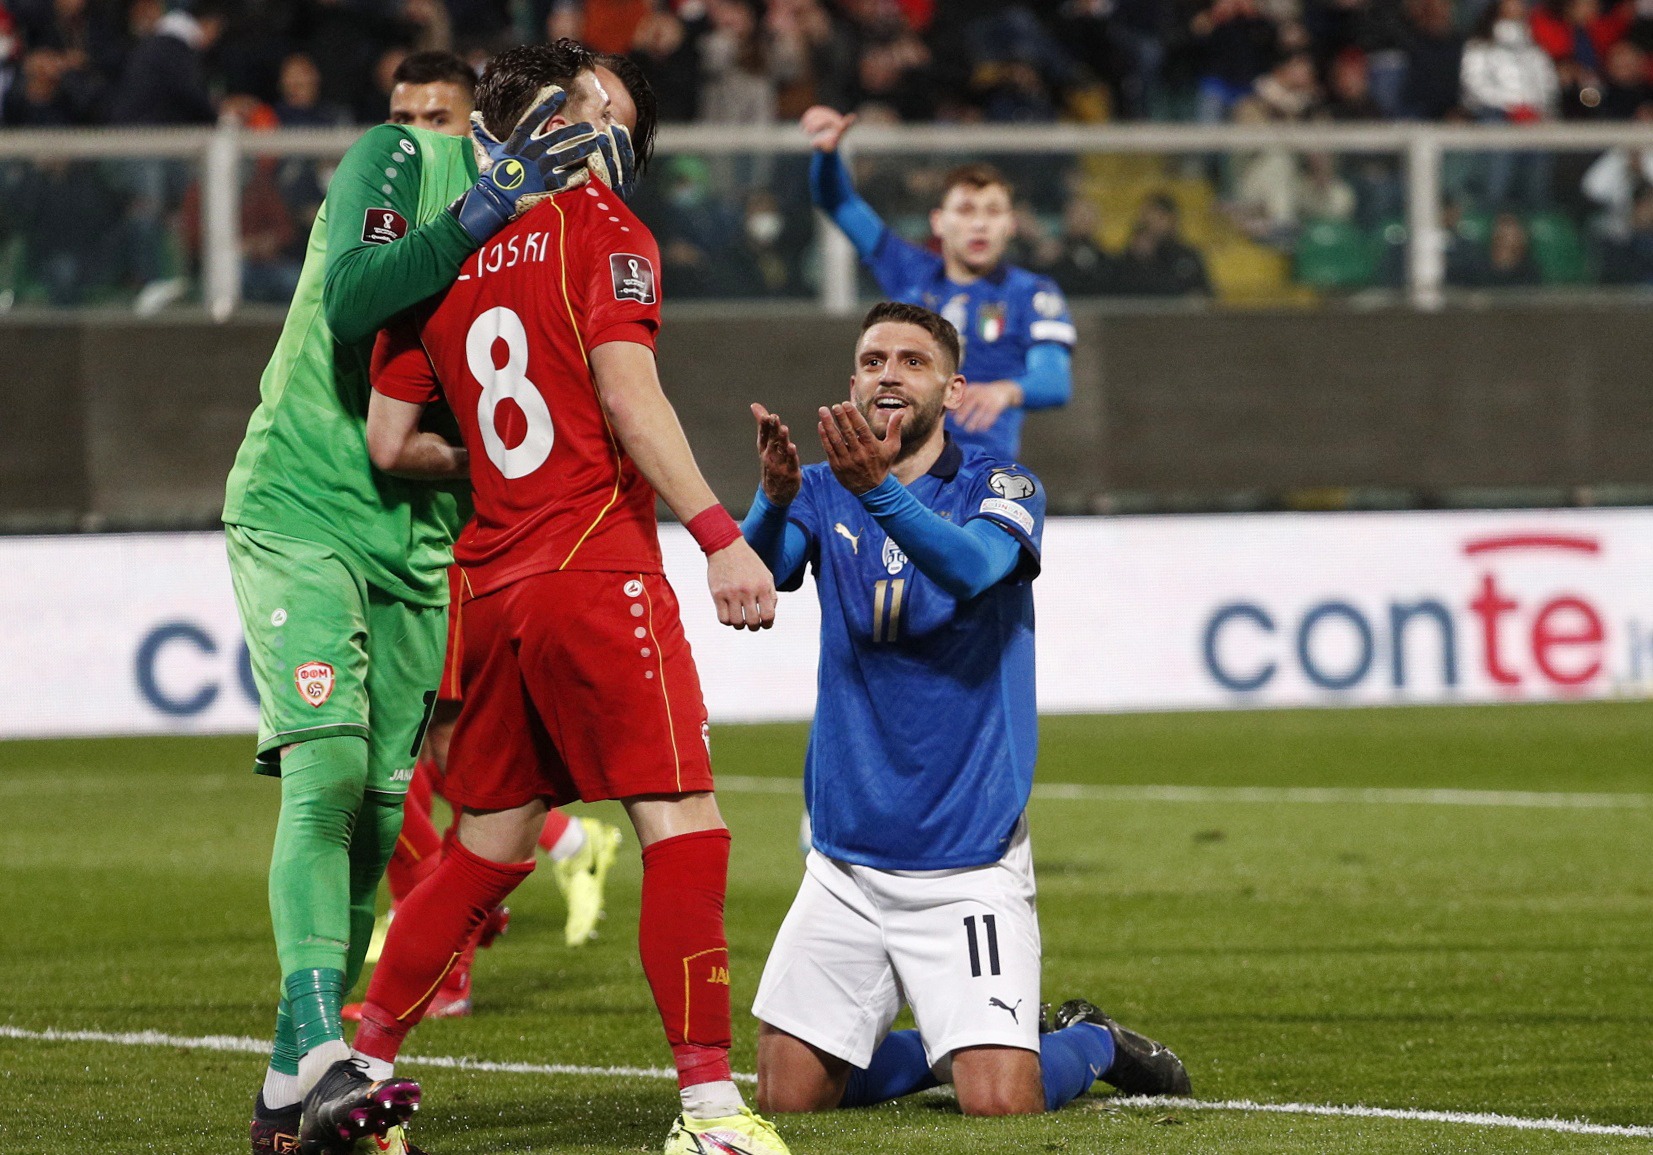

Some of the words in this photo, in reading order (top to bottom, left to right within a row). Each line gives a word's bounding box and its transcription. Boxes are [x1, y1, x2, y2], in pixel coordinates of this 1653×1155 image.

[457, 231, 550, 281] IOSKI
[465, 305, 555, 480] 8
[873, 578, 905, 642] 11
[1202, 572, 1605, 693] conte
[963, 914, 1001, 978] 11
